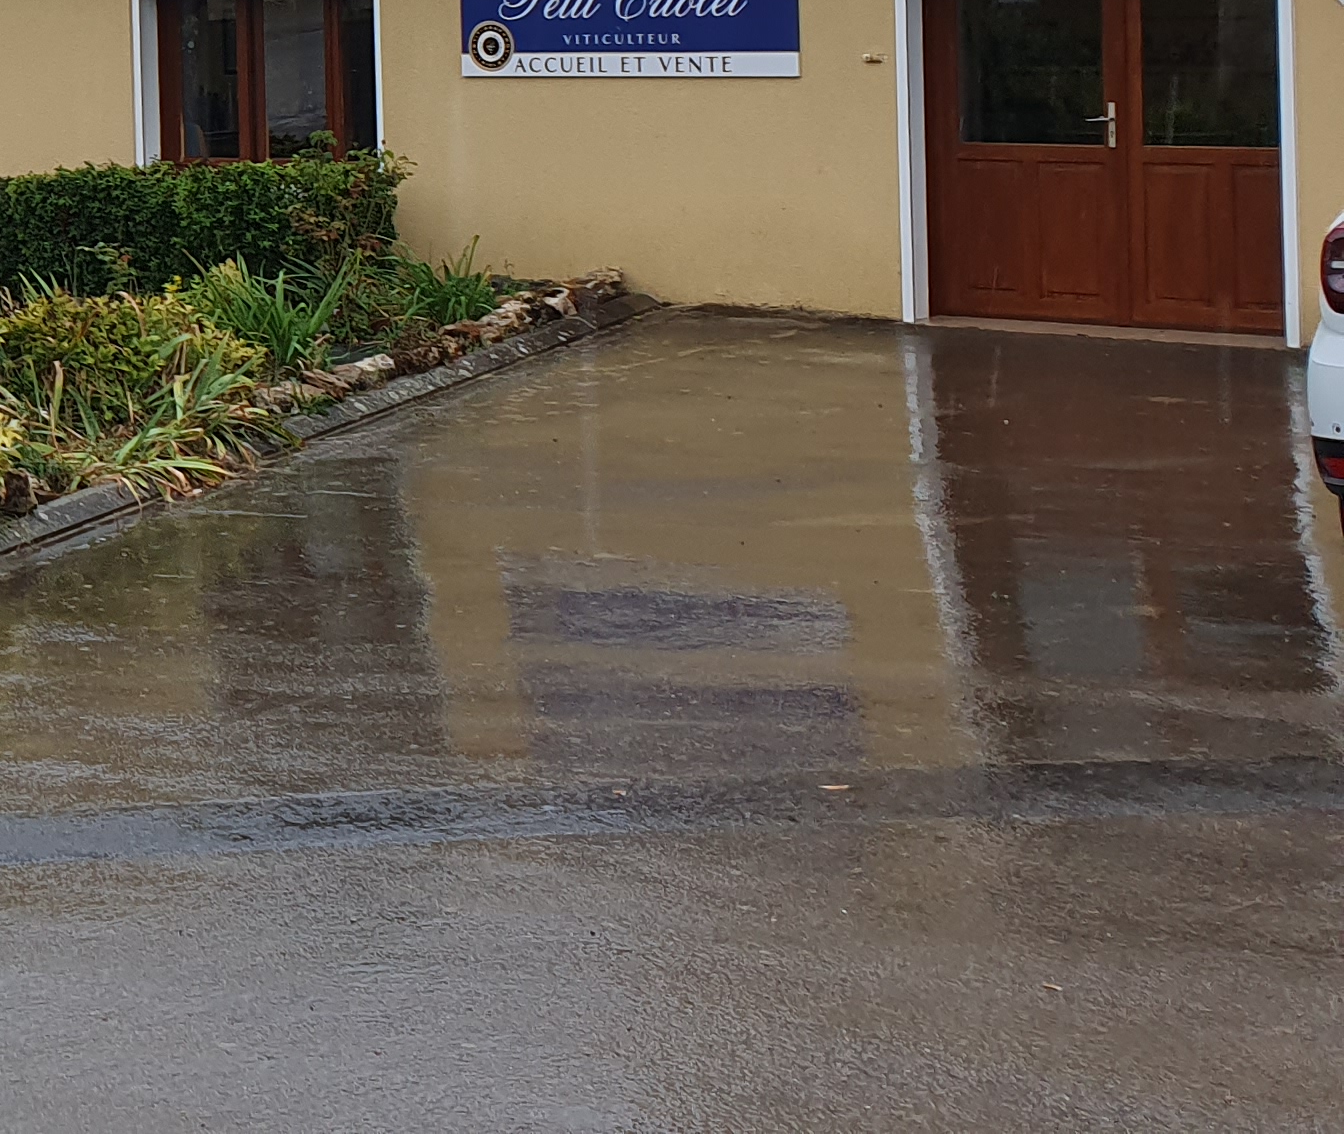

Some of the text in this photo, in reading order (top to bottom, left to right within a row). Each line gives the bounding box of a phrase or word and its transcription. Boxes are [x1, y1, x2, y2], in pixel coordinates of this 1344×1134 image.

[562, 33, 682, 46] VITICULTEUR
[514, 55, 734, 74] ACCUEIL ET VENTE
